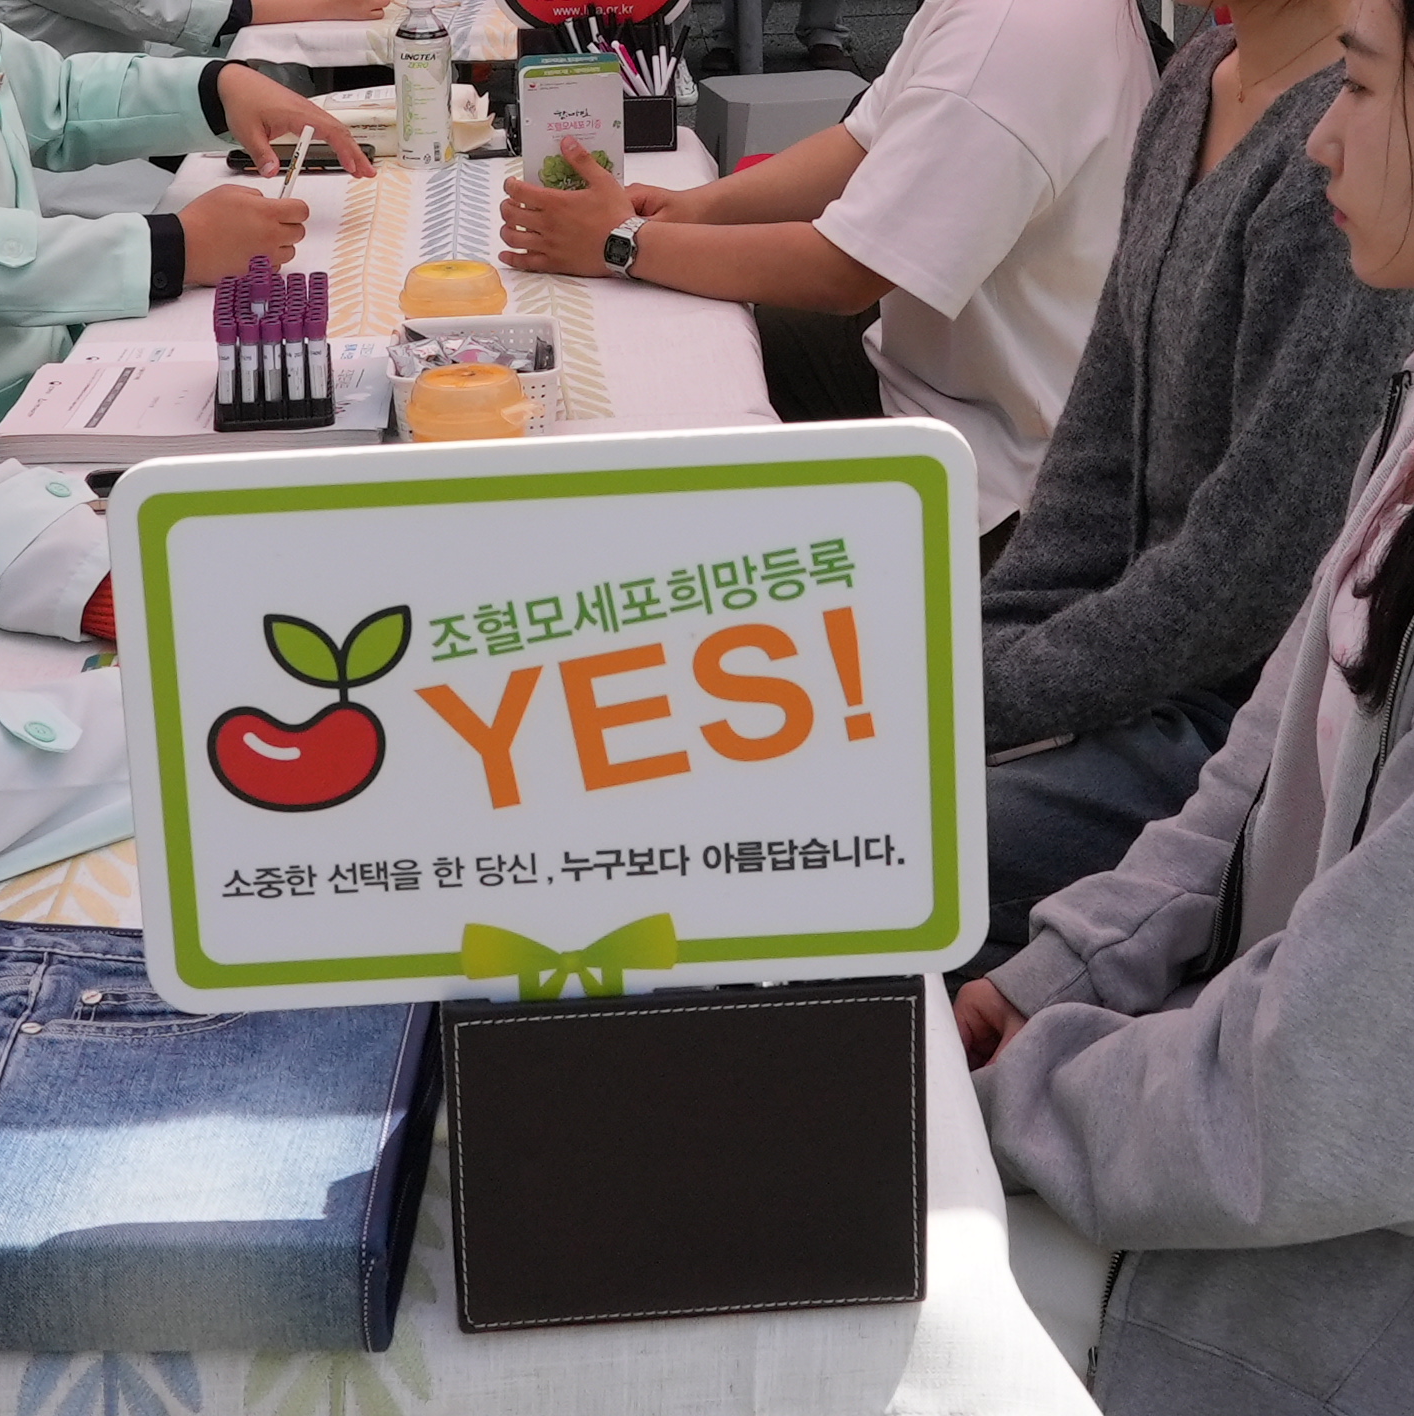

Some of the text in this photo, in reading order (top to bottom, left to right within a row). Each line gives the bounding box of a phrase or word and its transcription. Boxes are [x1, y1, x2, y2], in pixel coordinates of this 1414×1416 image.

[553, 4, 634, 16] www.la.or.kr
[429, 537, 857, 664] 조혈모세포희망등록
[415, 606, 876, 810] YES!
[222, 864, 318, 900] 소중한
[327, 859, 423, 894] 선택을
[432, 855, 466, 889] 한
[560, 844, 691, 882] 누구보다
[702, 834, 907, 874] 아름답습니다.
